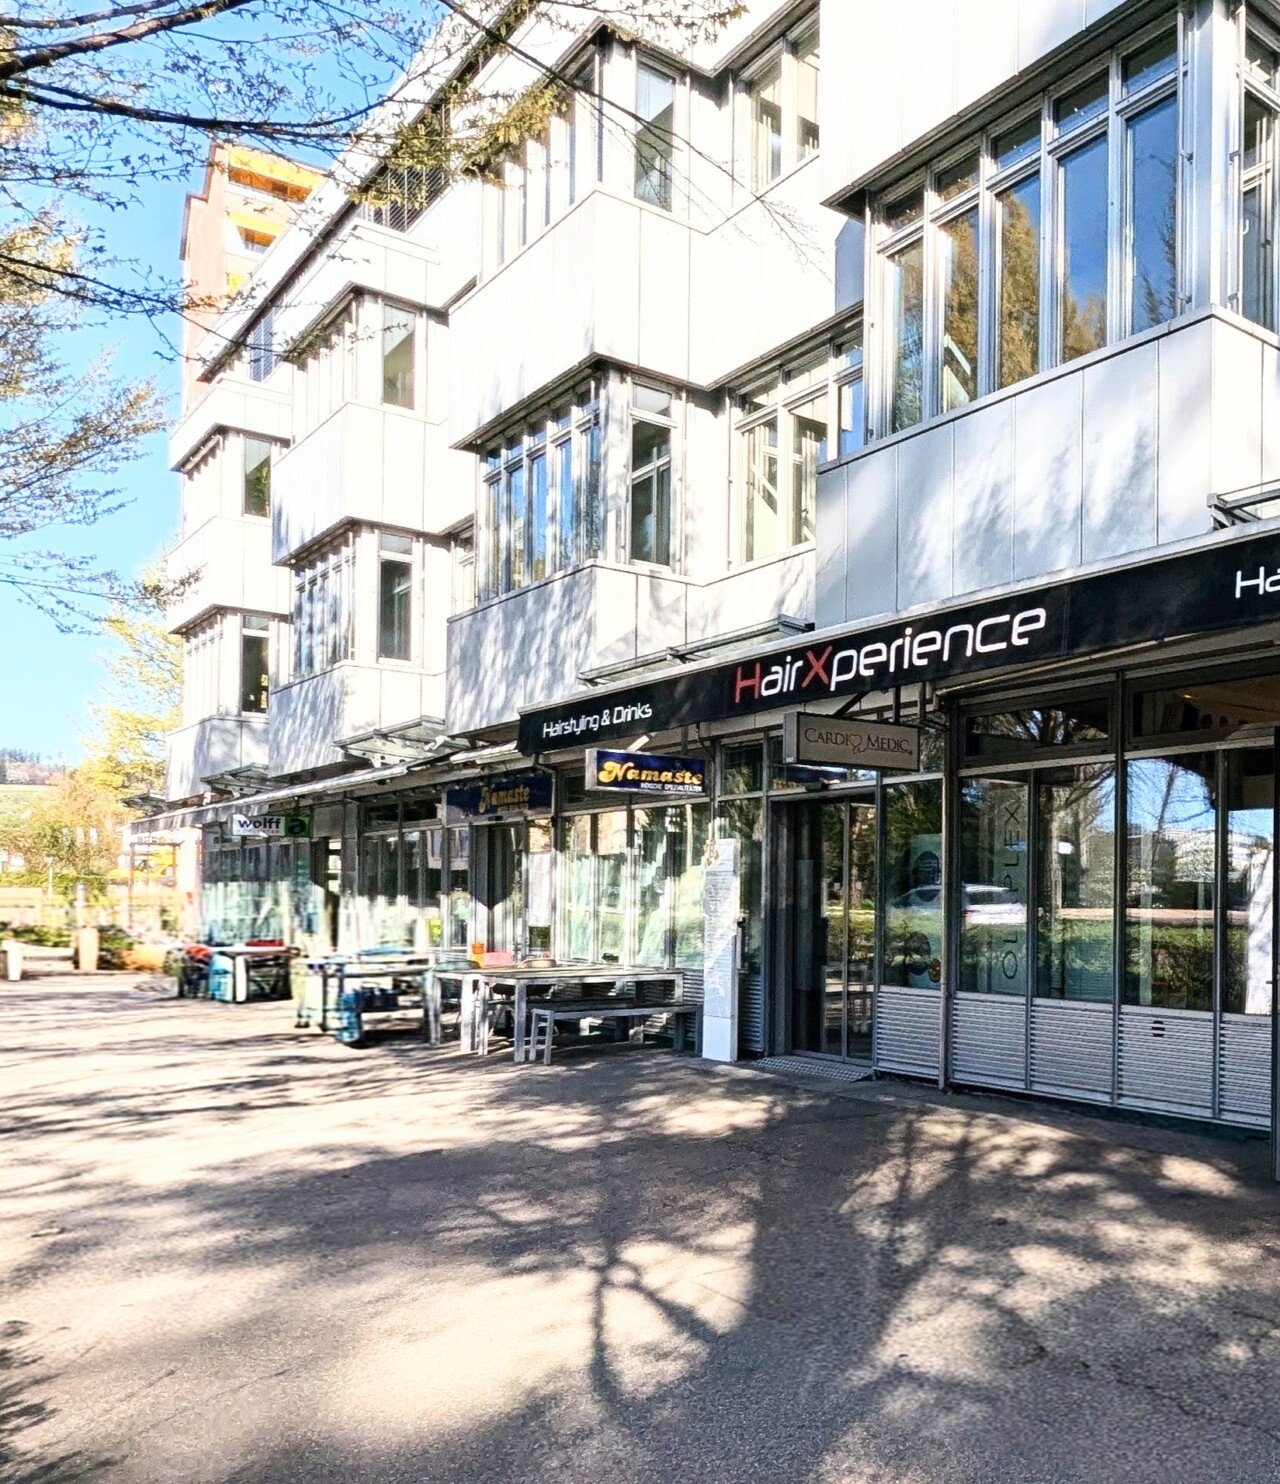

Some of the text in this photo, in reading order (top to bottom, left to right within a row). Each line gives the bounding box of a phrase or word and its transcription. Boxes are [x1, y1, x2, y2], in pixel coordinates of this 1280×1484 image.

[734, 607, 1047, 703] HairXperience
[542, 702, 653, 738] Hairstyling & Drinks
[598, 761, 703, 785] Namaste
[479, 784, 530, 814] Namaste
[238, 817, 281, 829] wolff
[1002, 805, 1020, 980] OLPLEX
